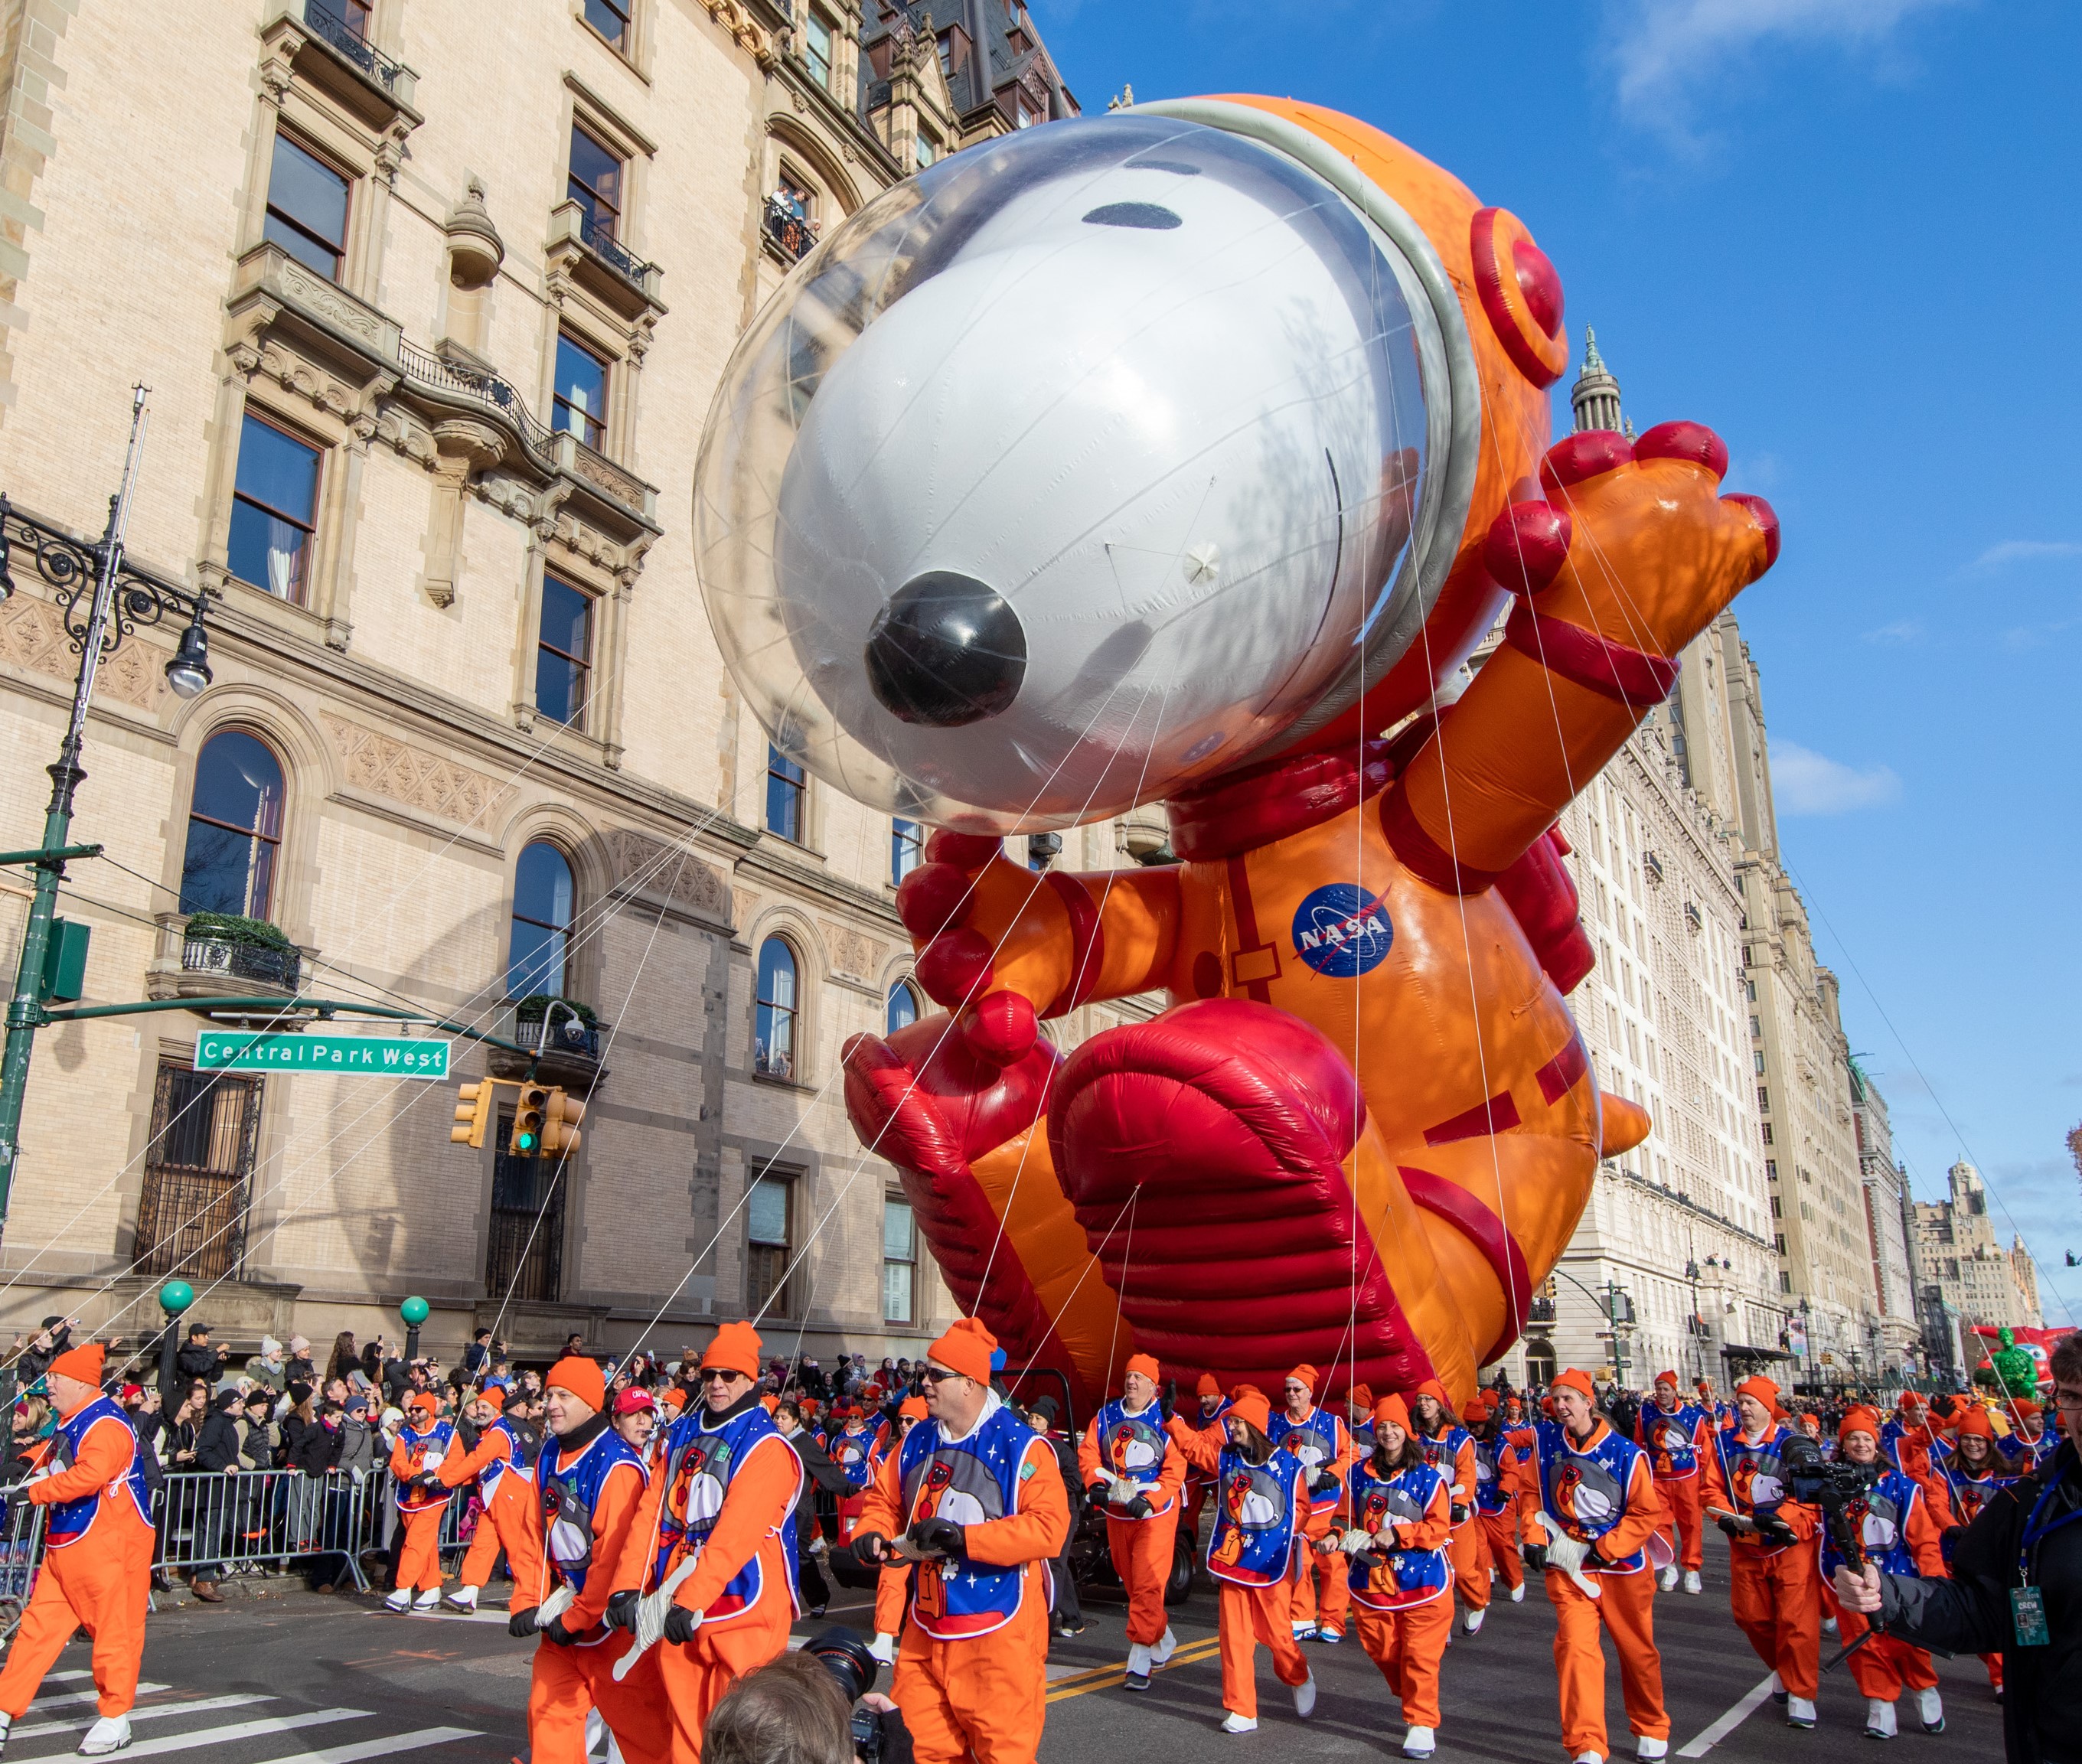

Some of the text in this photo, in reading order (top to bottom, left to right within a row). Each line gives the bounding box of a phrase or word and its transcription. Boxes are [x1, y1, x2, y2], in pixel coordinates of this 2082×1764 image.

[1299, 916, 1388, 950] NASA
[204, 1042, 442, 1068] Central Park West
[2018, 1601, 2037, 1610] CREW
